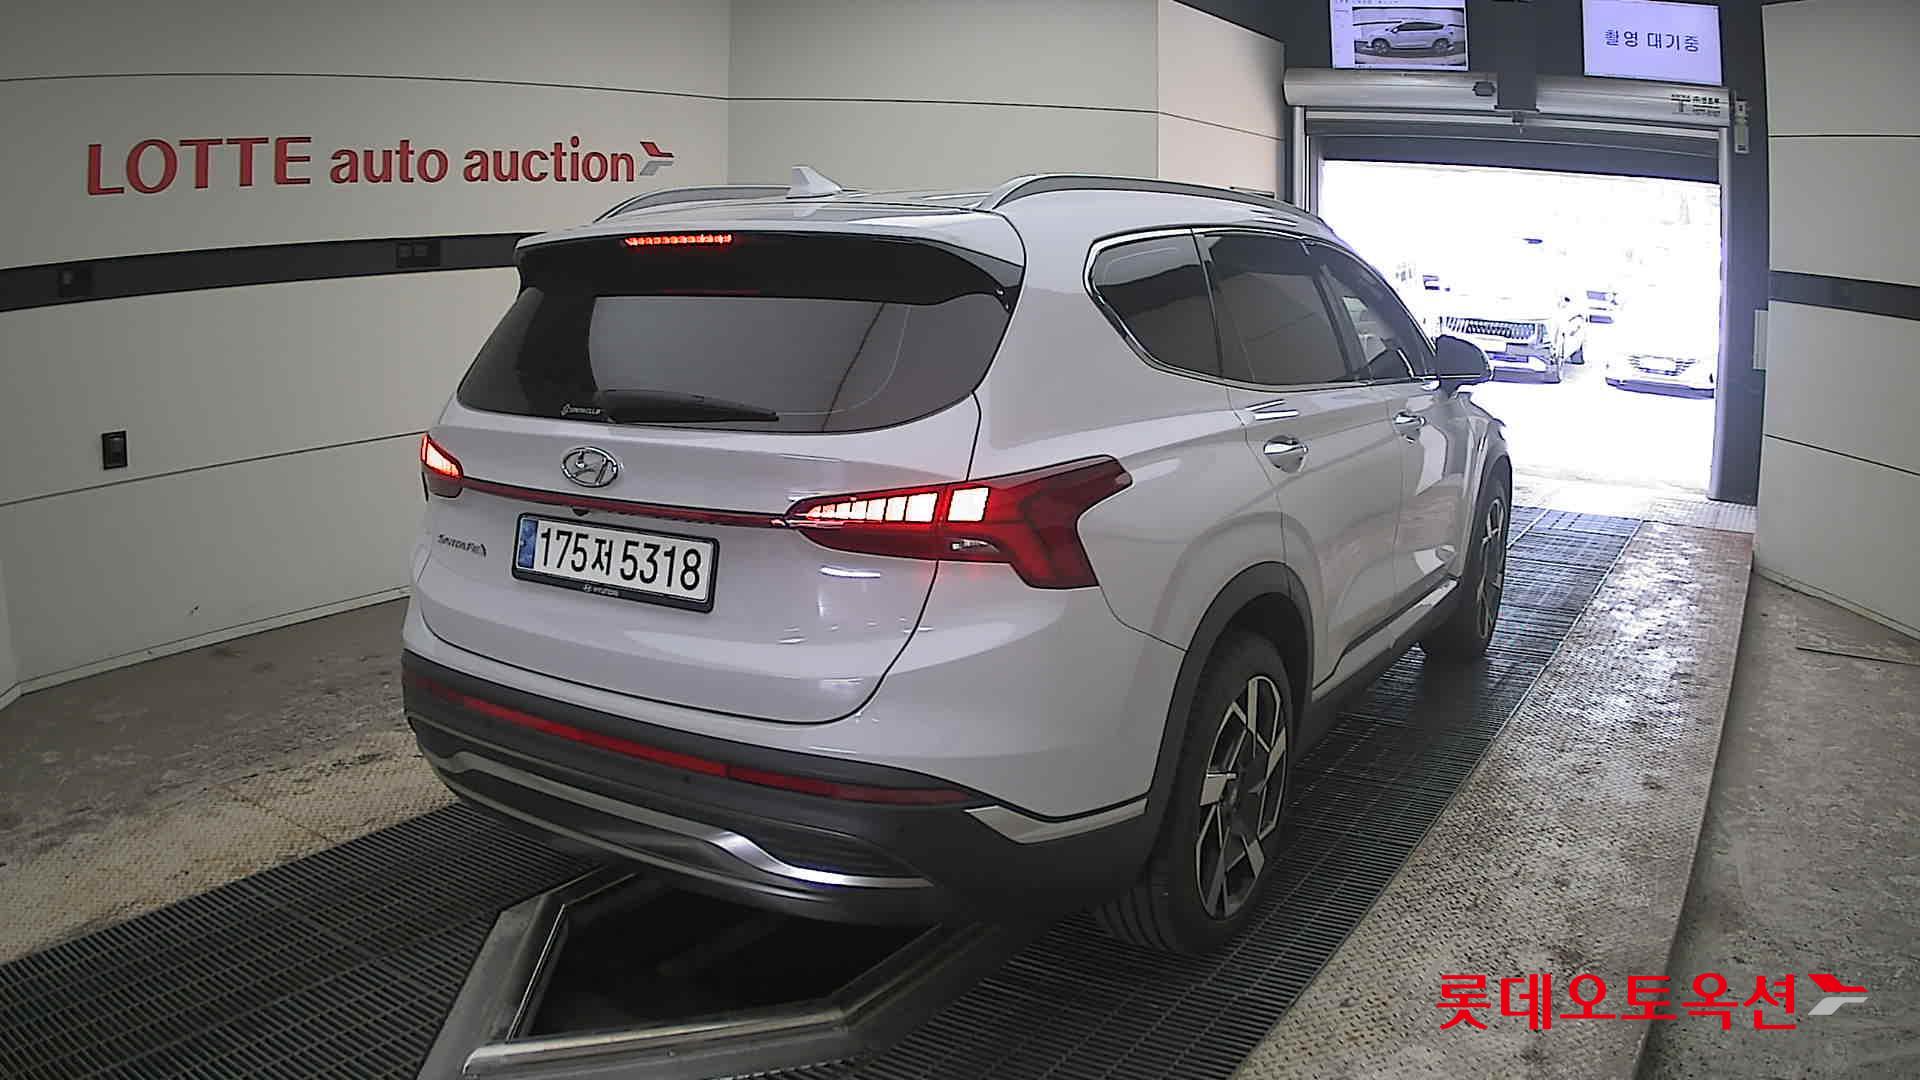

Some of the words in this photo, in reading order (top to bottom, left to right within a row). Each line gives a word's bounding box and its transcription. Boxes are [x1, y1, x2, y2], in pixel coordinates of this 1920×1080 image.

[1647, 32, 1699, 52] 대기중
[87, 135, 312, 196] LOTTE
[329, 139, 449, 185] auto
[463, 135, 636, 184] auction
[540, 527, 613, 576] 175저
[620, 541, 702, 592] 5318
